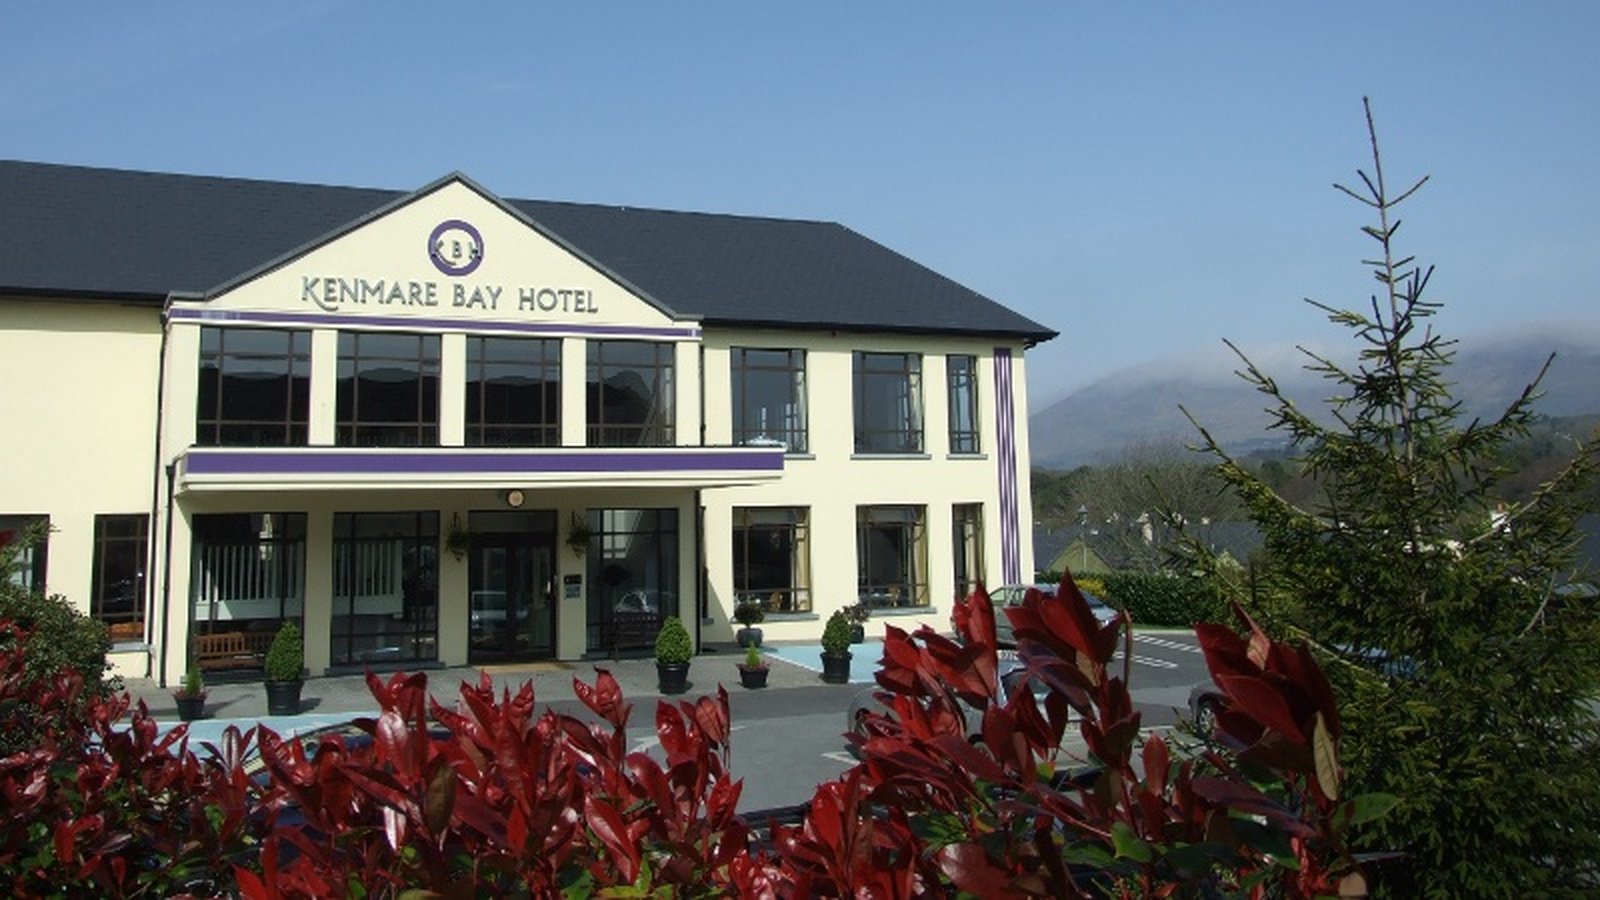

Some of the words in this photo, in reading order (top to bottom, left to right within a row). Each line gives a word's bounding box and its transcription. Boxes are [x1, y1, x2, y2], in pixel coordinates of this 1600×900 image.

[302, 275, 438, 312] KENMARE
[452, 284, 503, 310] BAY
[519, 288, 599, 313] HOTEL
